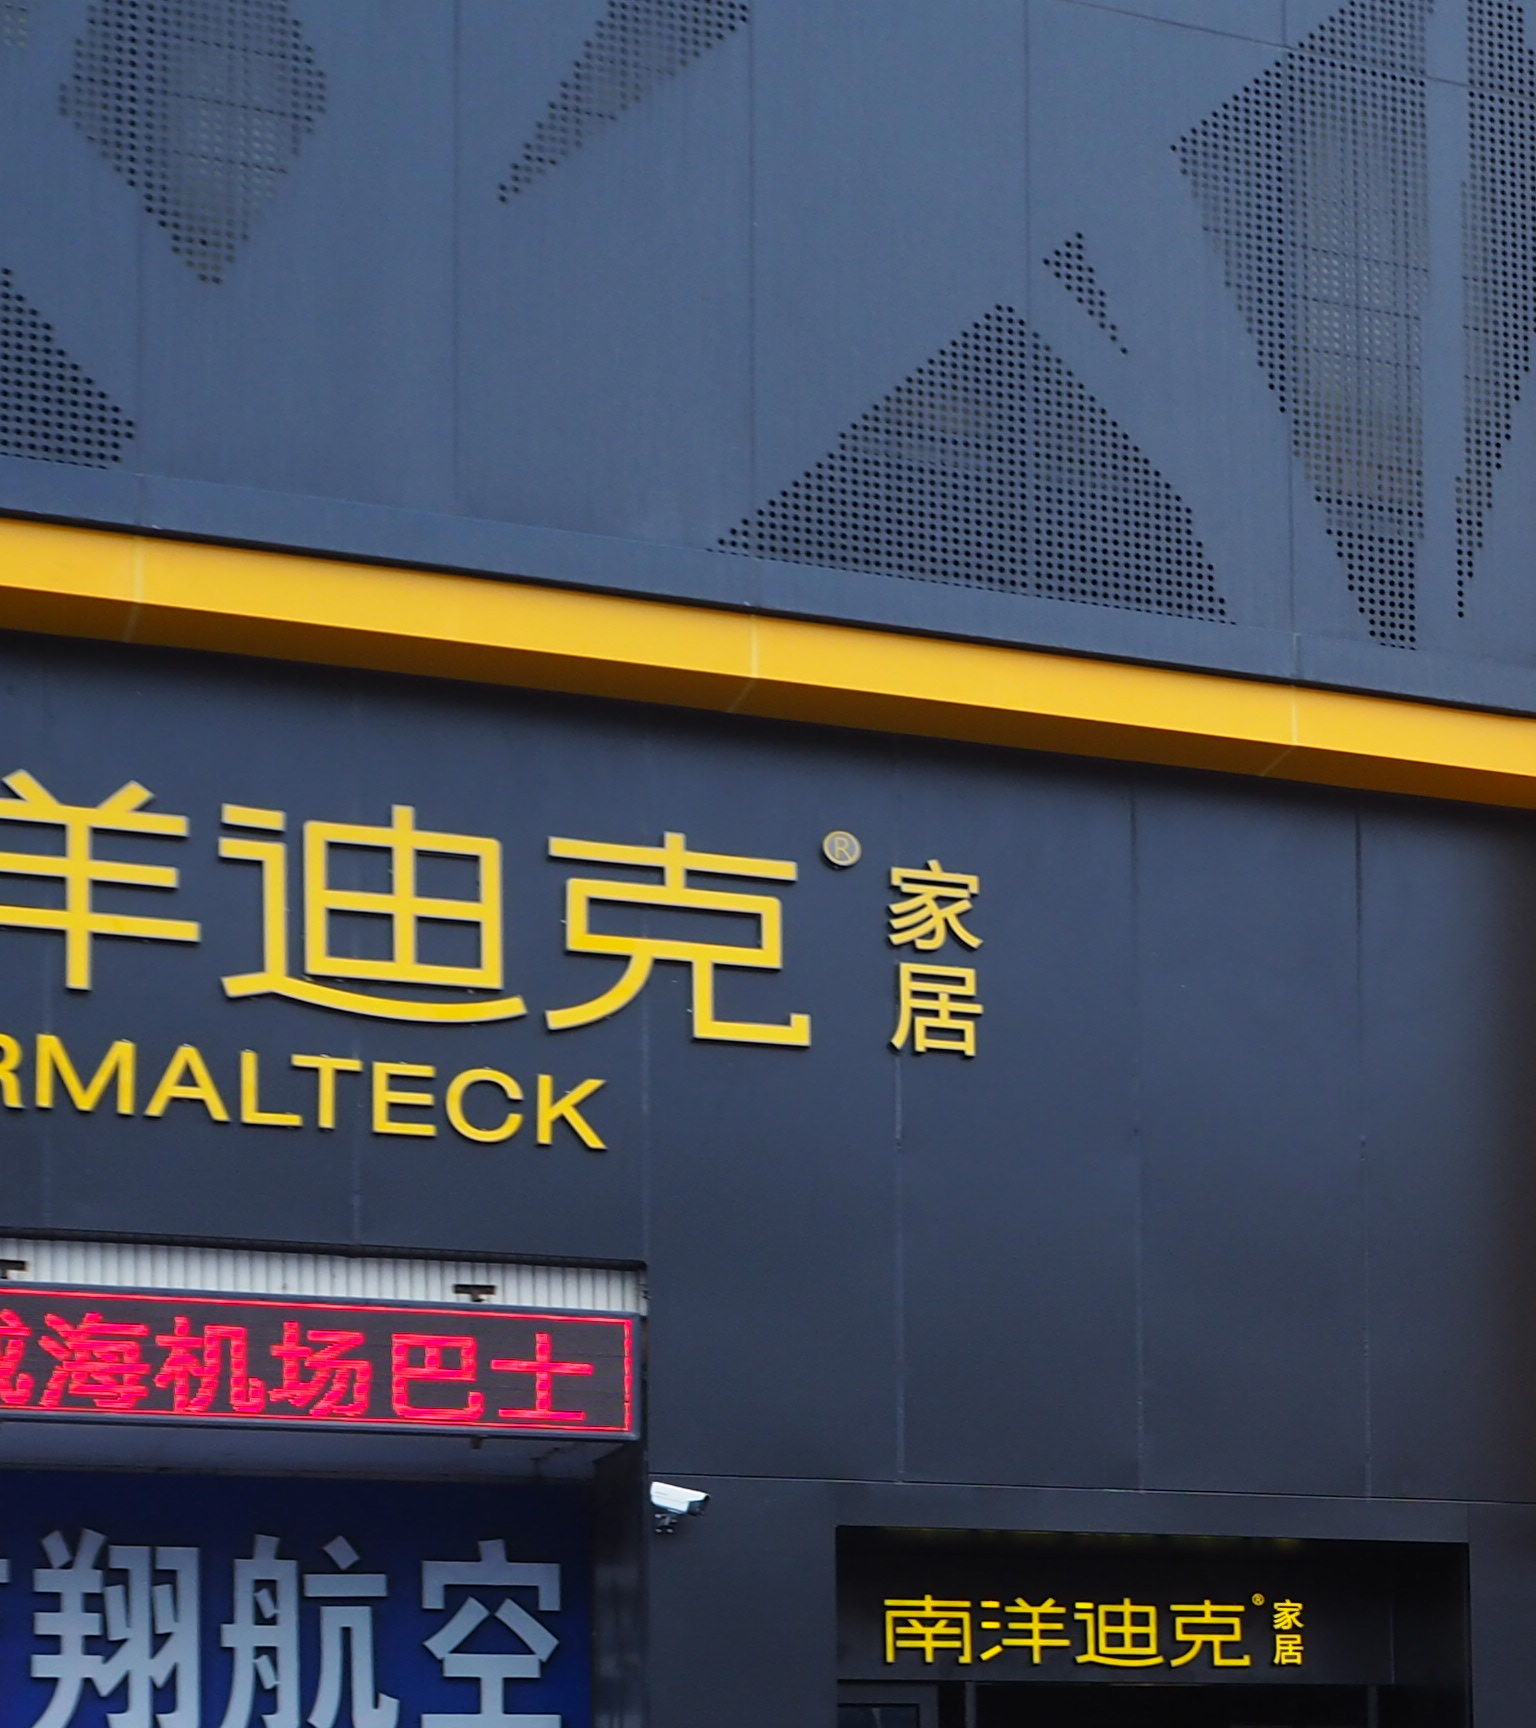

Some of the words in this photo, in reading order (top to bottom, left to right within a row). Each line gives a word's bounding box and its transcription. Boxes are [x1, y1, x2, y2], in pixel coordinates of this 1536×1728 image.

[887, 859, 983, 1057] 家居
[883, 1594, 1252, 1668] 南洋迪克
[1272, 1599, 1305, 1666] 家居
